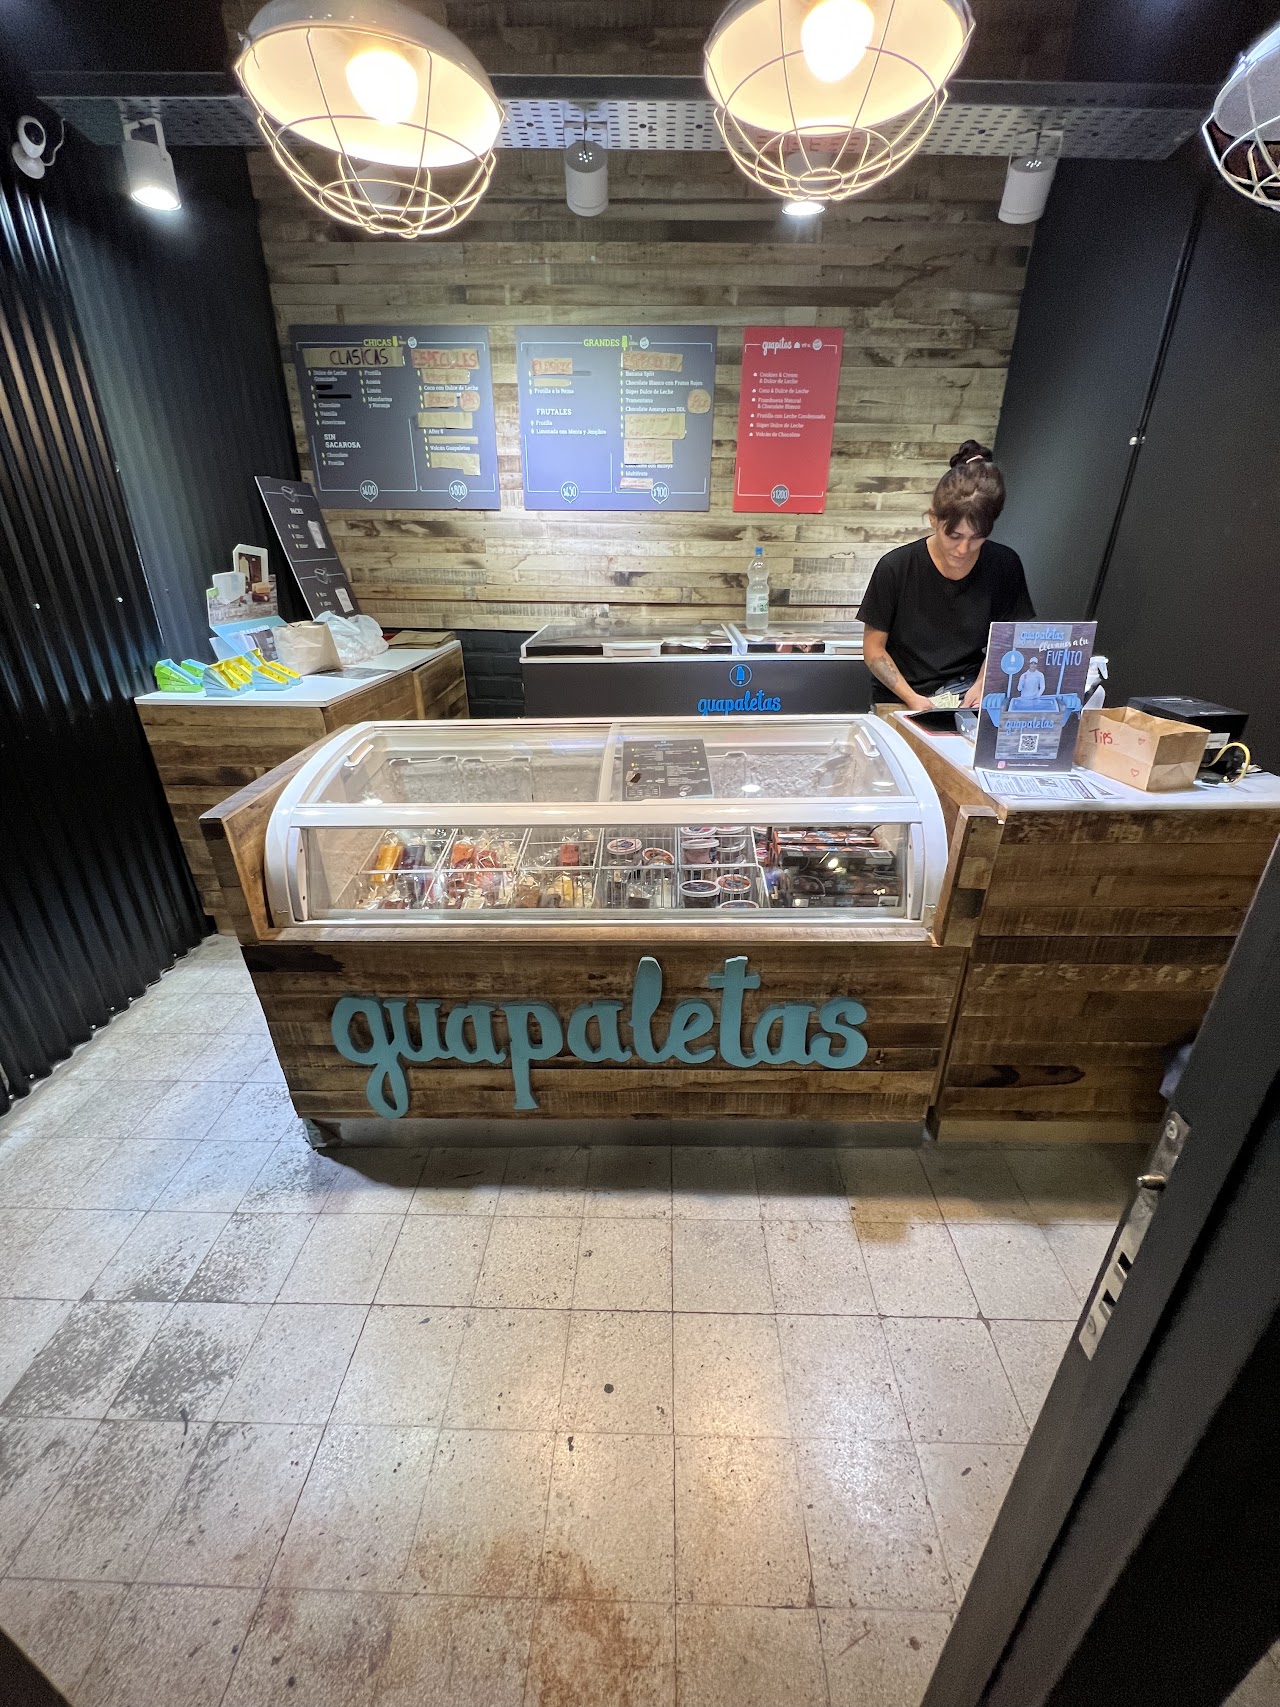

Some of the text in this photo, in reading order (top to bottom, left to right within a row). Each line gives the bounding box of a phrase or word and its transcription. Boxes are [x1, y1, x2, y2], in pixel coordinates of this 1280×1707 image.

[364, 338, 392, 346] CHICAS
[583, 338, 620, 347] GRANDES
[654, 486, 667, 497] $900
[1021, 628, 1064, 645] guapaletas
[1080, 637, 1088, 646] tu
[1046, 650, 1083, 666] EVENTO
[698, 690, 781, 716] guapaletas
[1005, 714, 1054, 736] guapaletas
[1089, 728, 1112, 745] Tips
[330, 956, 868, 1118] guapaletas
